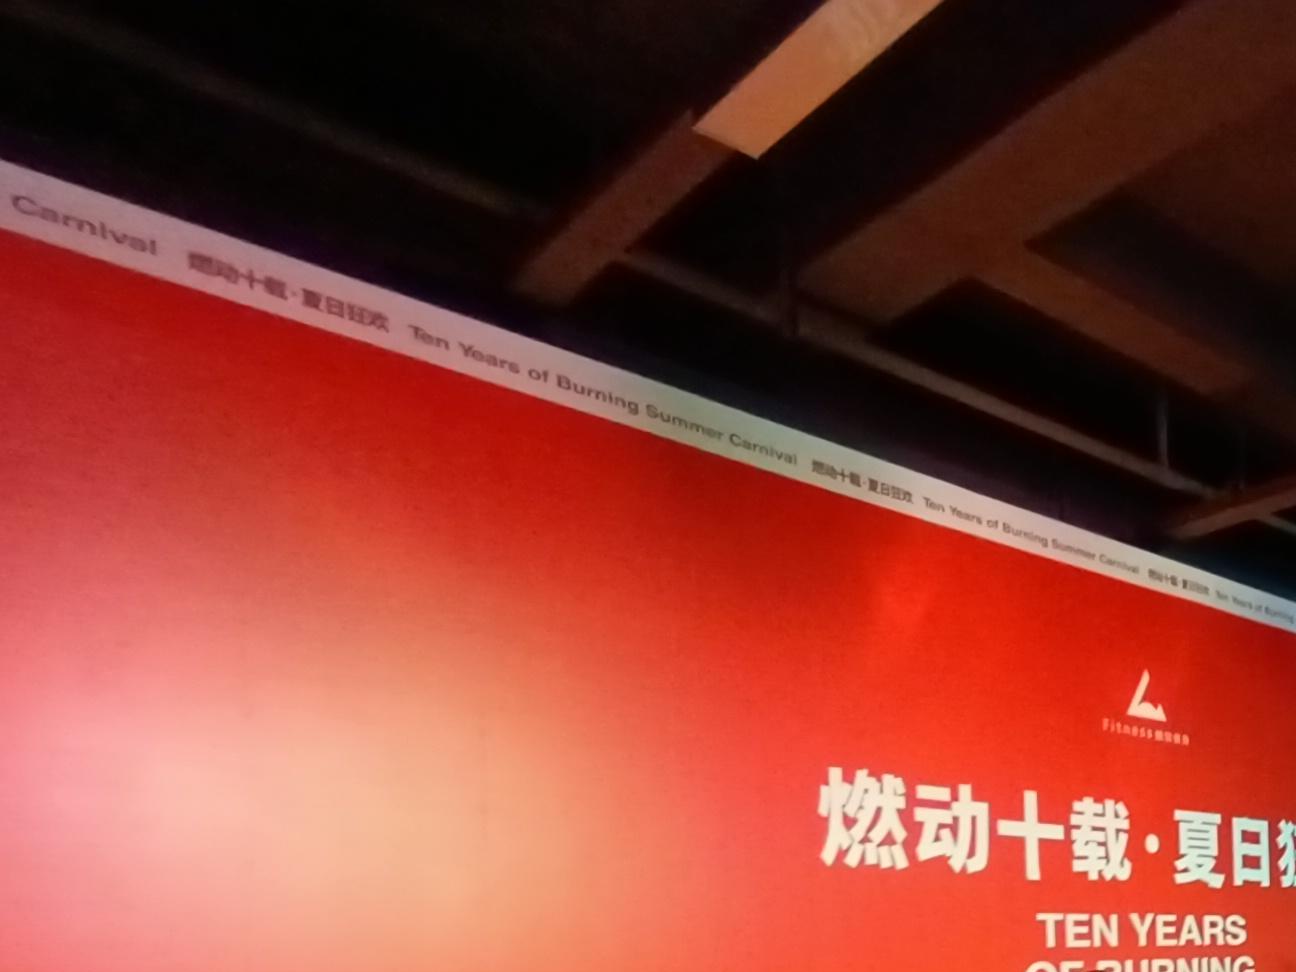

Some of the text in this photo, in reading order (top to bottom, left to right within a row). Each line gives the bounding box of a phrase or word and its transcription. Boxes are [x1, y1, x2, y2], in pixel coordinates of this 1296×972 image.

[11, 193, 158, 257] Carnival
[408, 324, 798, 467] Ten Years of Burning Summer Carnival
[922, 496, 946, 513] Ten
[949, 504, 983, 526] Years
[986, 518, 999, 529] of
[1002, 522, 1049, 549] Burning
[1036, 912, 1248, 949] TEN YEARS
